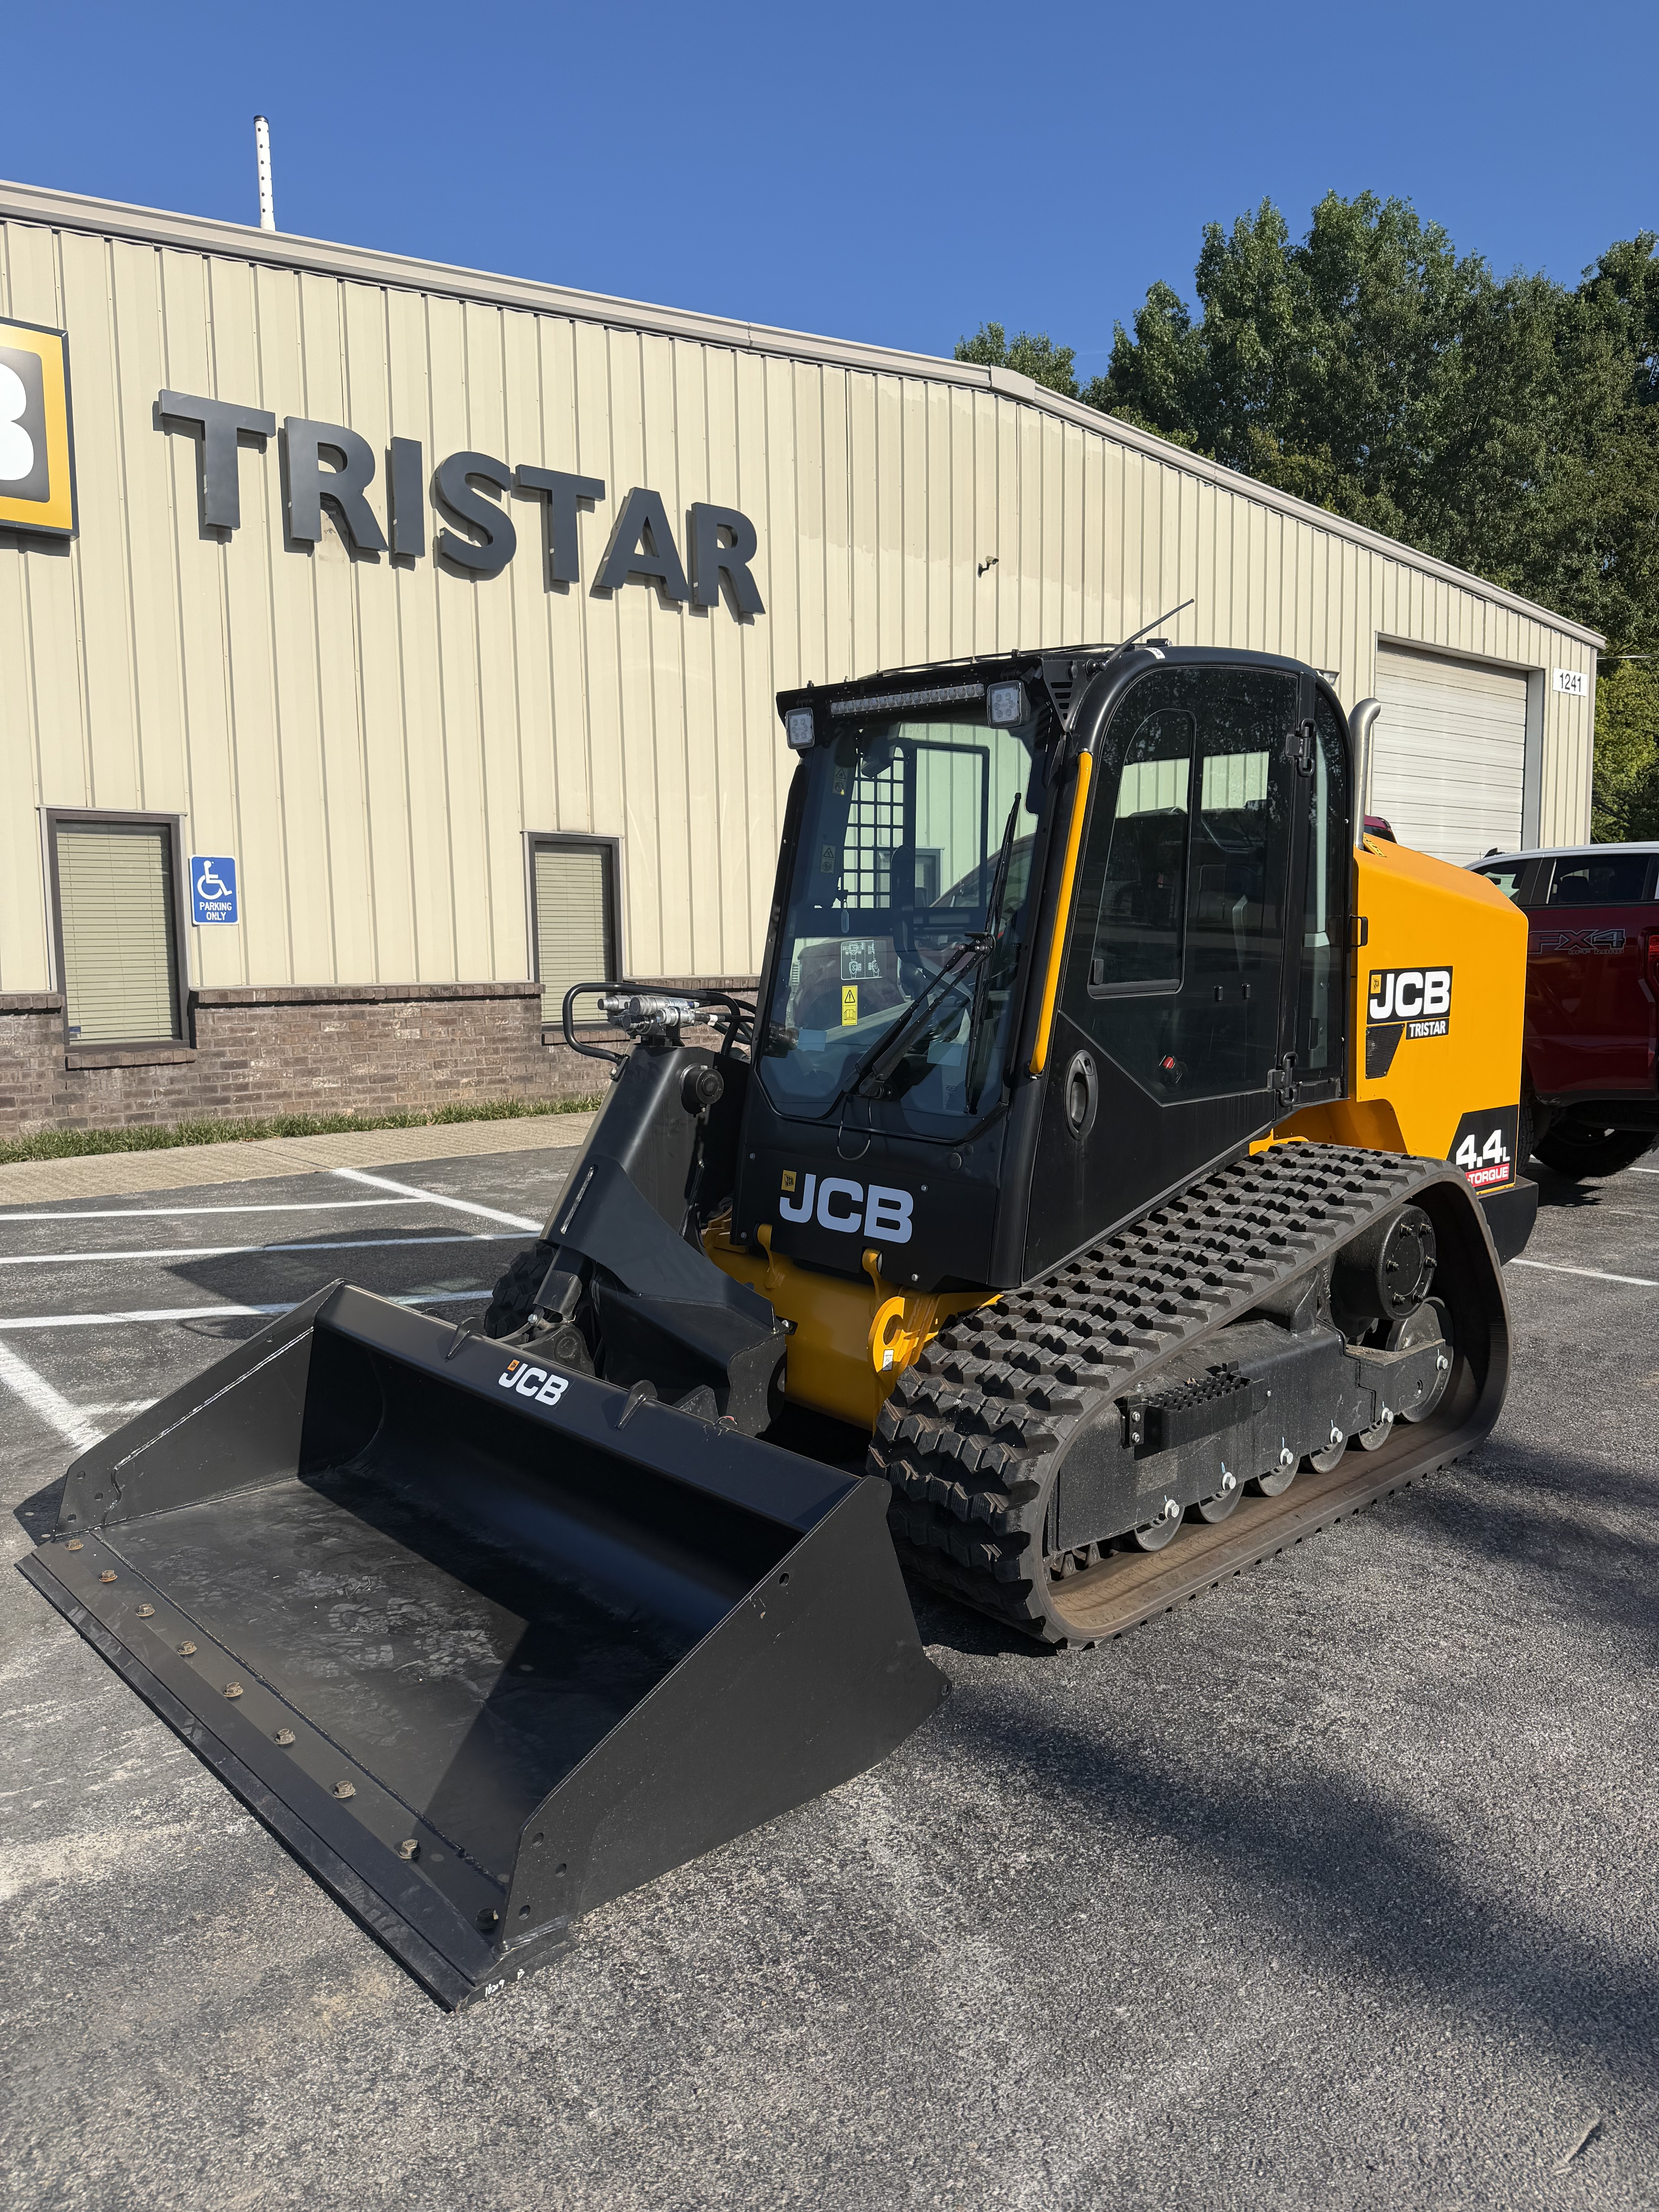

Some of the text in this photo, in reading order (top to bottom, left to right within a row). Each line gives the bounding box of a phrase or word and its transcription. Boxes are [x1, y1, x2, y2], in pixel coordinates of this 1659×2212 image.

[158, 389, 766, 616] TRISTAR
[1559, 672, 1581, 692] 1241
[199, 902, 232, 911] PARKING
[206, 912, 226, 921] ONLY
[1528, 929, 1626, 954] FX4
[1370, 971, 1450, 1019] JCB
[1409, 1020, 1446, 1037] TRISTAR
[1456, 1129, 1510, 1170] 4.4L
[1467, 1166, 1508, 1184] -TORQUE
[780, 1173, 914, 1243] JCB
[498, 1363, 569, 1406] JCB
